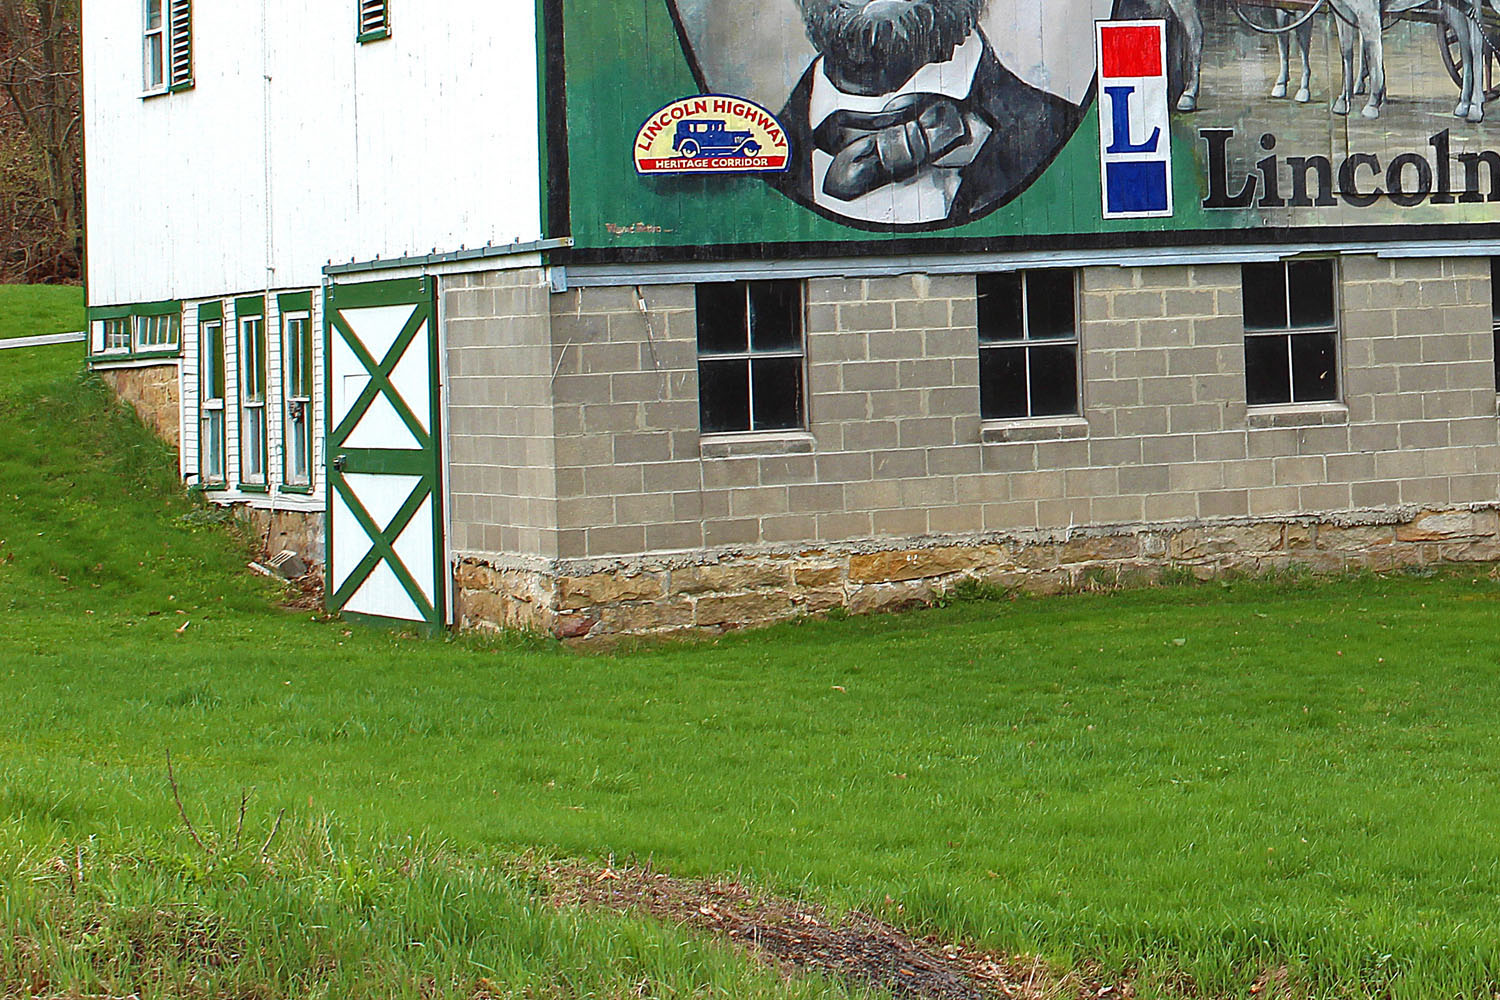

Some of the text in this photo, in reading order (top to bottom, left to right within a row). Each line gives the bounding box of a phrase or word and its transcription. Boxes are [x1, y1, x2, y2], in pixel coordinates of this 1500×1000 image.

[638, 99, 787, 151] LINCOLN HIGHWAY
[1106, 85, 1161, 154] L
[655, 158, 768, 169] HERITAGE CORRIDOR
